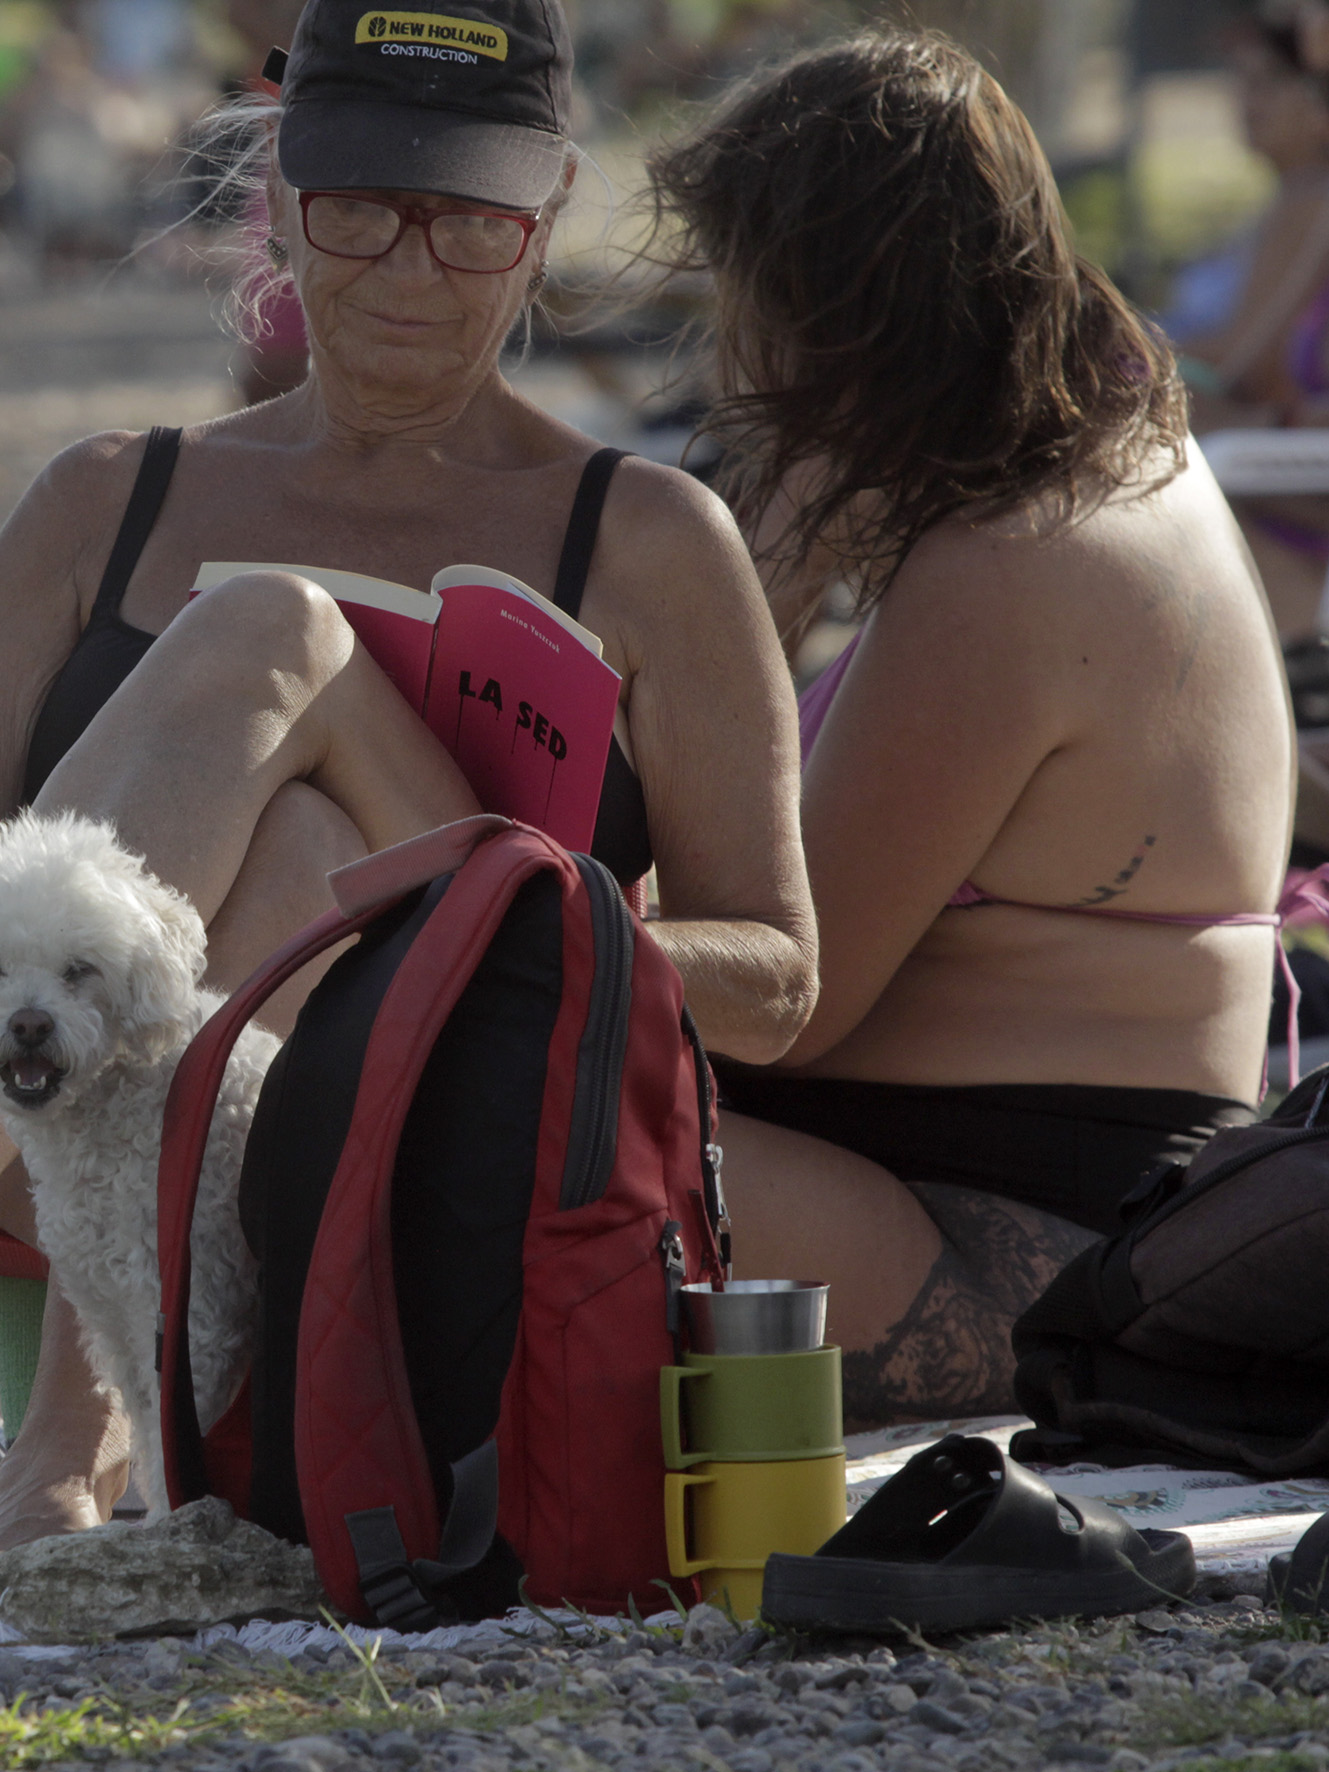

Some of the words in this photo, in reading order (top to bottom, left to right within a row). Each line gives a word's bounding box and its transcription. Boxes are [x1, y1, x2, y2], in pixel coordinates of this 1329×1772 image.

[389, 21, 425, 36] NEW
[428, 24, 498, 49] HOLLAND
[381, 43, 478, 65] CONSTRUCTION
[500, 609, 529, 629] Marina
[458, 670, 503, 712] LA
[517, 701, 567, 761] SED
